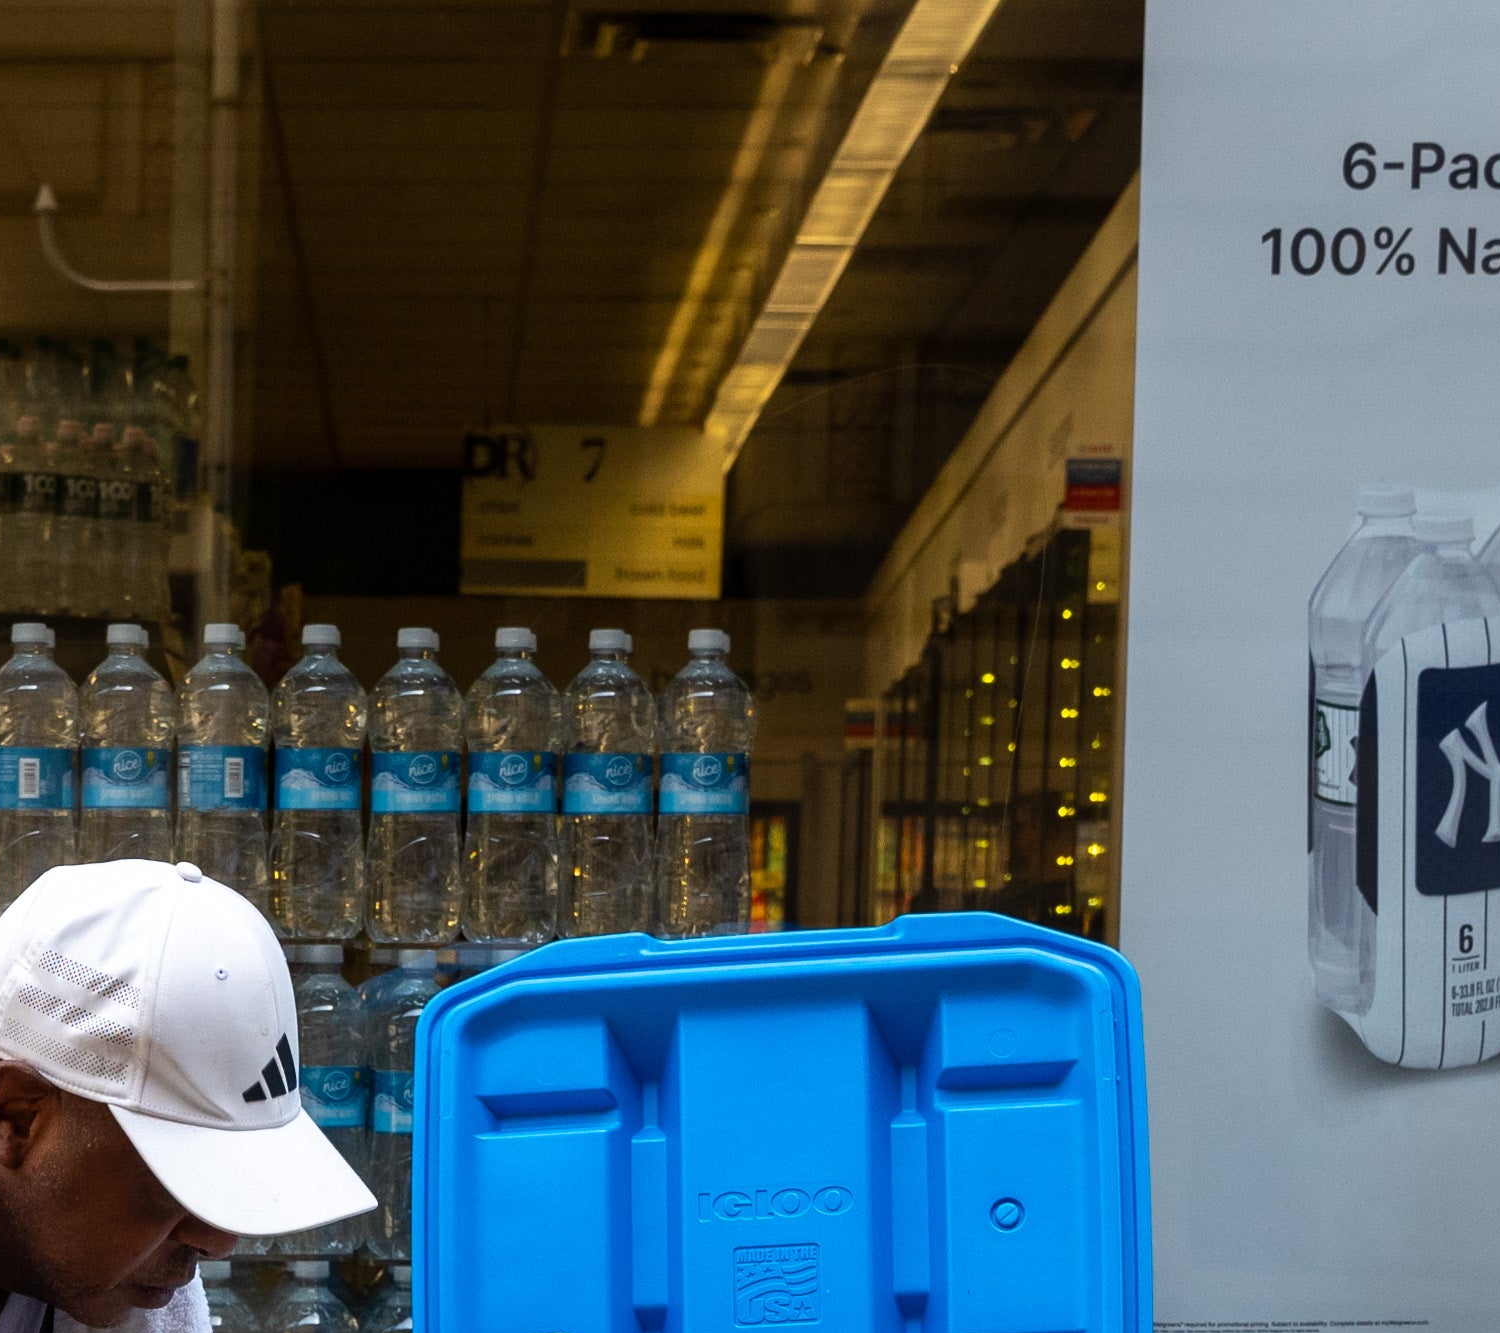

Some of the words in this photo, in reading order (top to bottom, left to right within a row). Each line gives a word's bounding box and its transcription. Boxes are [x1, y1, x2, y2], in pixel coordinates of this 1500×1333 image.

[1261, 227, 1416, 277] 100%
[580, 437, 605, 482] 7
[1458, 923, 1475, 954] 6
[1458, 961, 1480, 972] LITER
[697, 1184, 855, 1224] IGLOO
[736, 1247, 772, 1264] MADE
[790, 1245, 818, 1262] THE
[739, 1295, 820, 1326] USA
